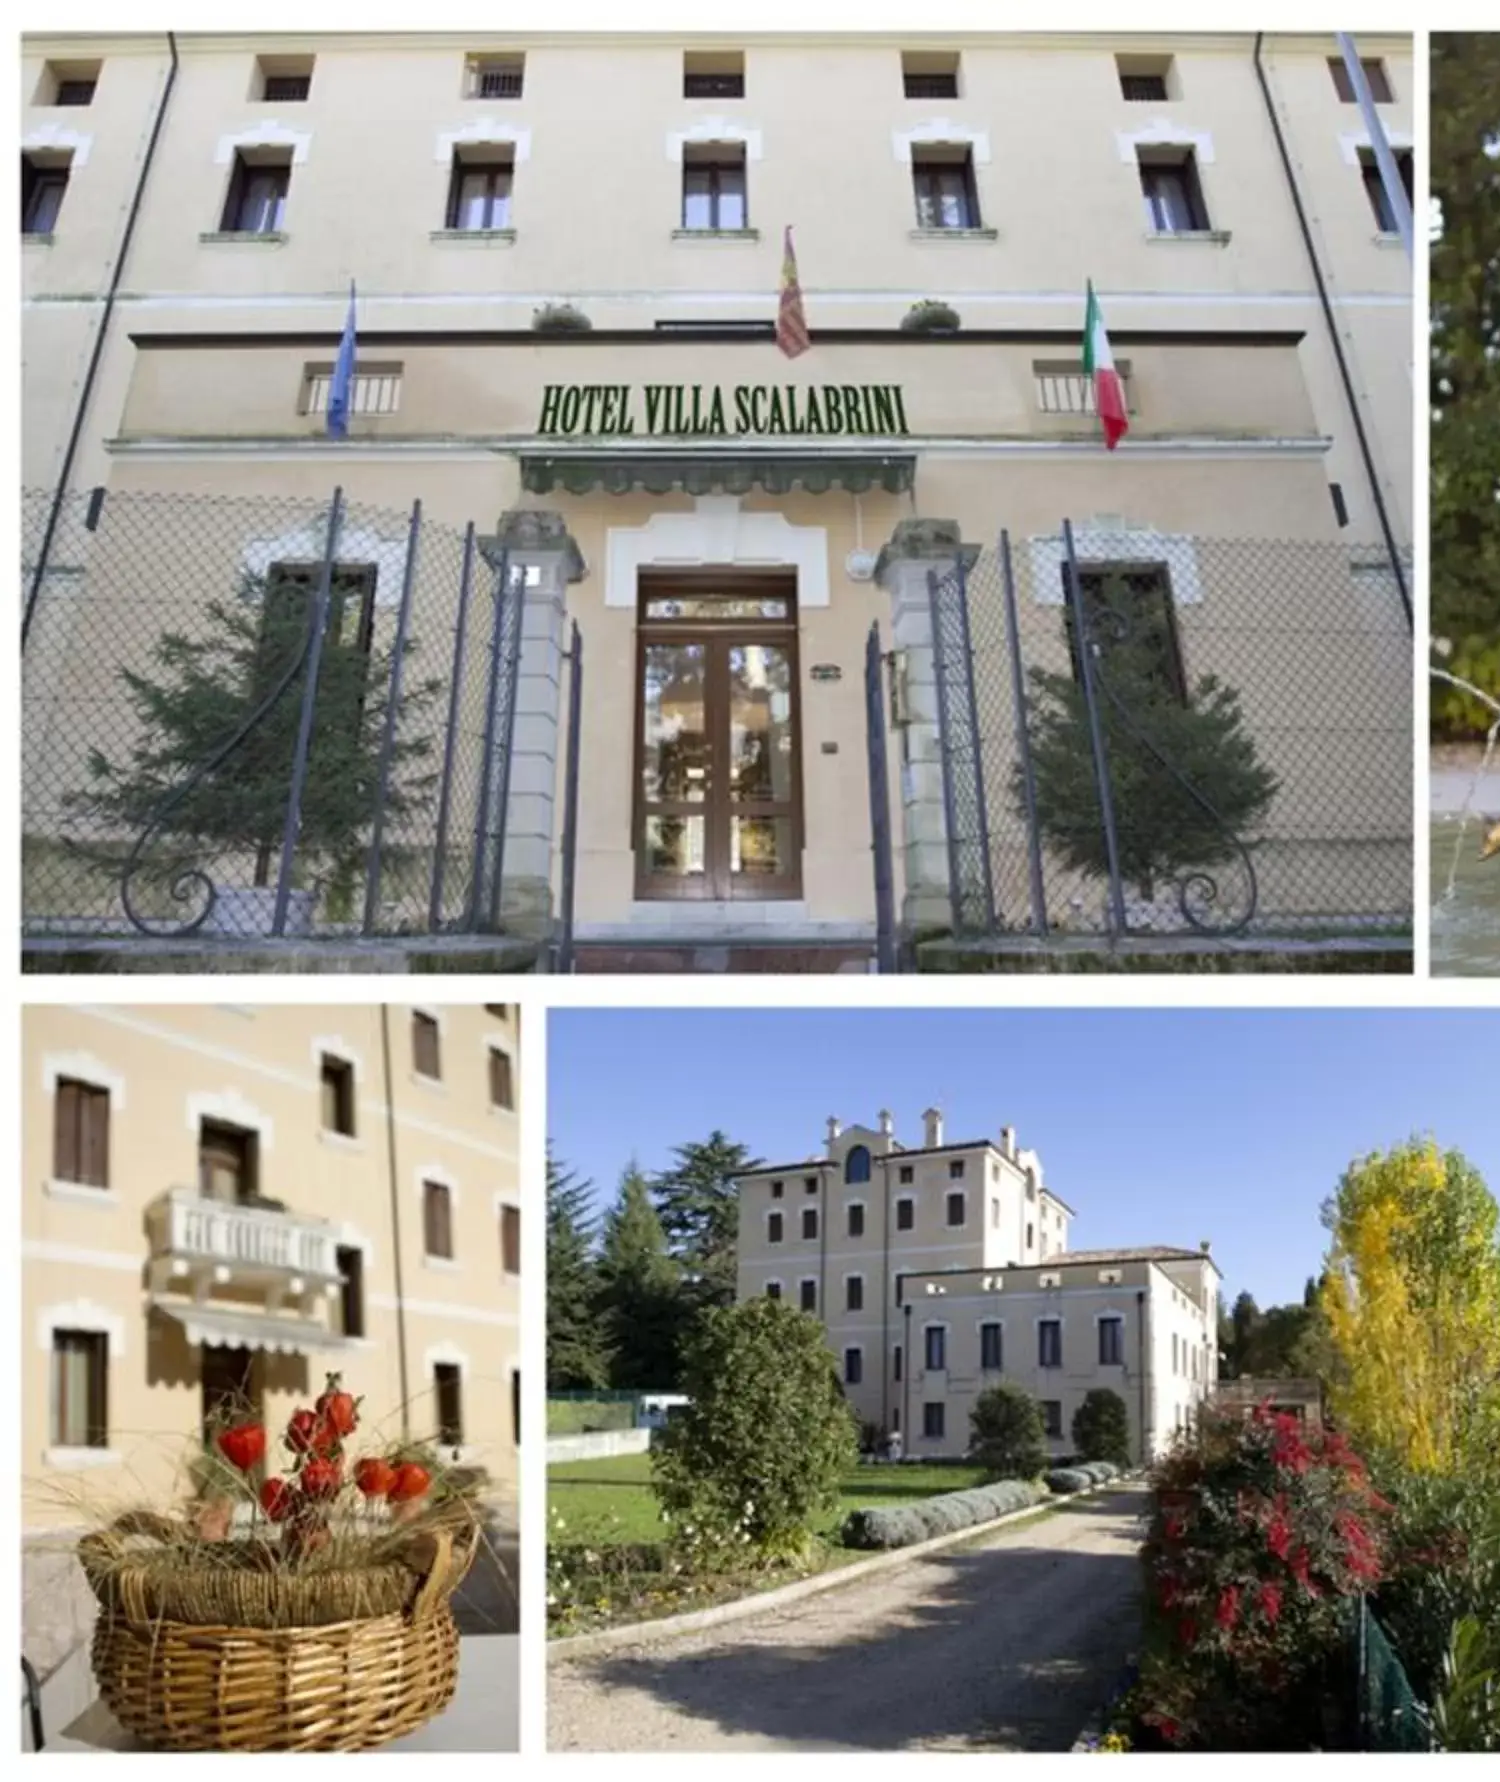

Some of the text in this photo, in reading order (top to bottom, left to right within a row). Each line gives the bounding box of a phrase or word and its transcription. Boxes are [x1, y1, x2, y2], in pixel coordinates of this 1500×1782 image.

[538, 385, 909, 434] HOTEL VILLA SCALABRINI
